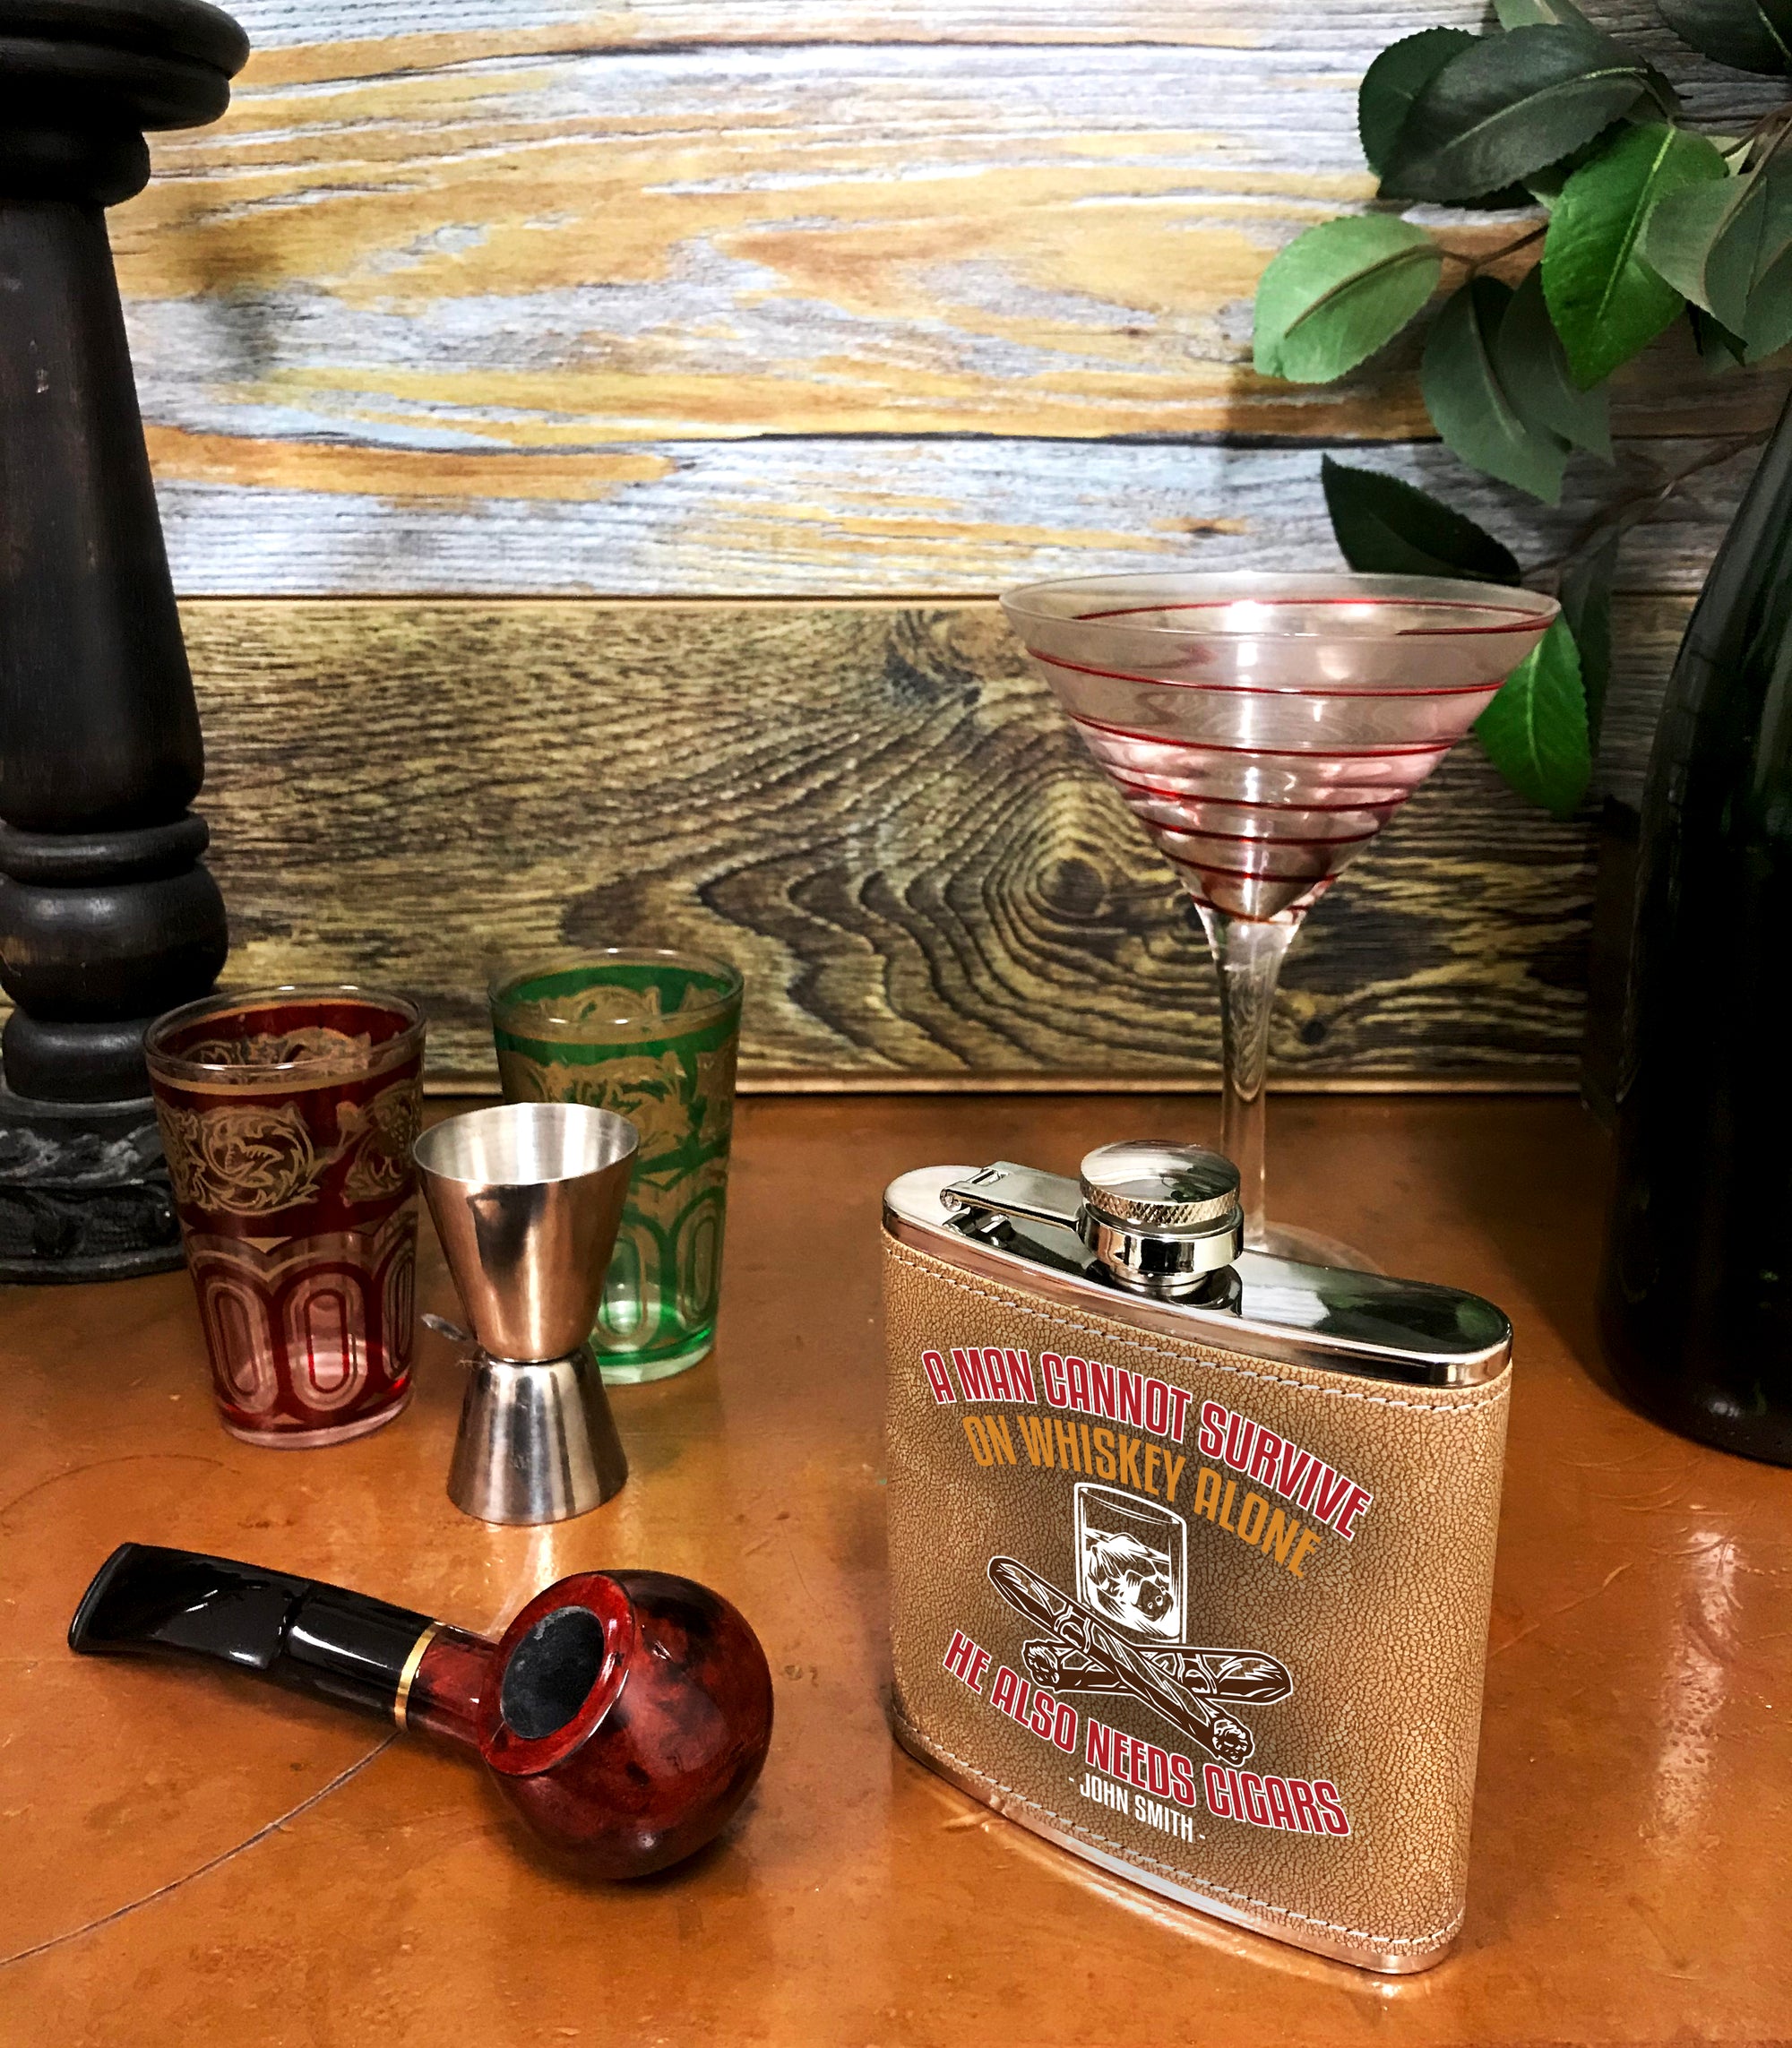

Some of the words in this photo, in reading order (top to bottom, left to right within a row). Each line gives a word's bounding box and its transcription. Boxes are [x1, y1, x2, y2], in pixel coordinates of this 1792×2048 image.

[921, 1350, 956, 1404] A
[952, 1347, 1038, 1404] MAN
[1039, 1352, 1193, 1444] CANNOT
[1198, 1401, 1374, 1542] SURVIVE
[962, 1416, 1017, 1467] ON
[1019, 1416, 1185, 1502] WHISKEY
[1193, 1467, 1322, 1579] ALONE
[943, 1629, 992, 1695] HE
[989, 1665, 1078, 1753] ALSO
[1085, 1717, 1196, 1808] NEEDS
[1202, 1762, 1351, 1837] CIGARS
[1080, 1773, 1129, 1815] JOHN
[1134, 1794, 1193, 1843] SMITH
